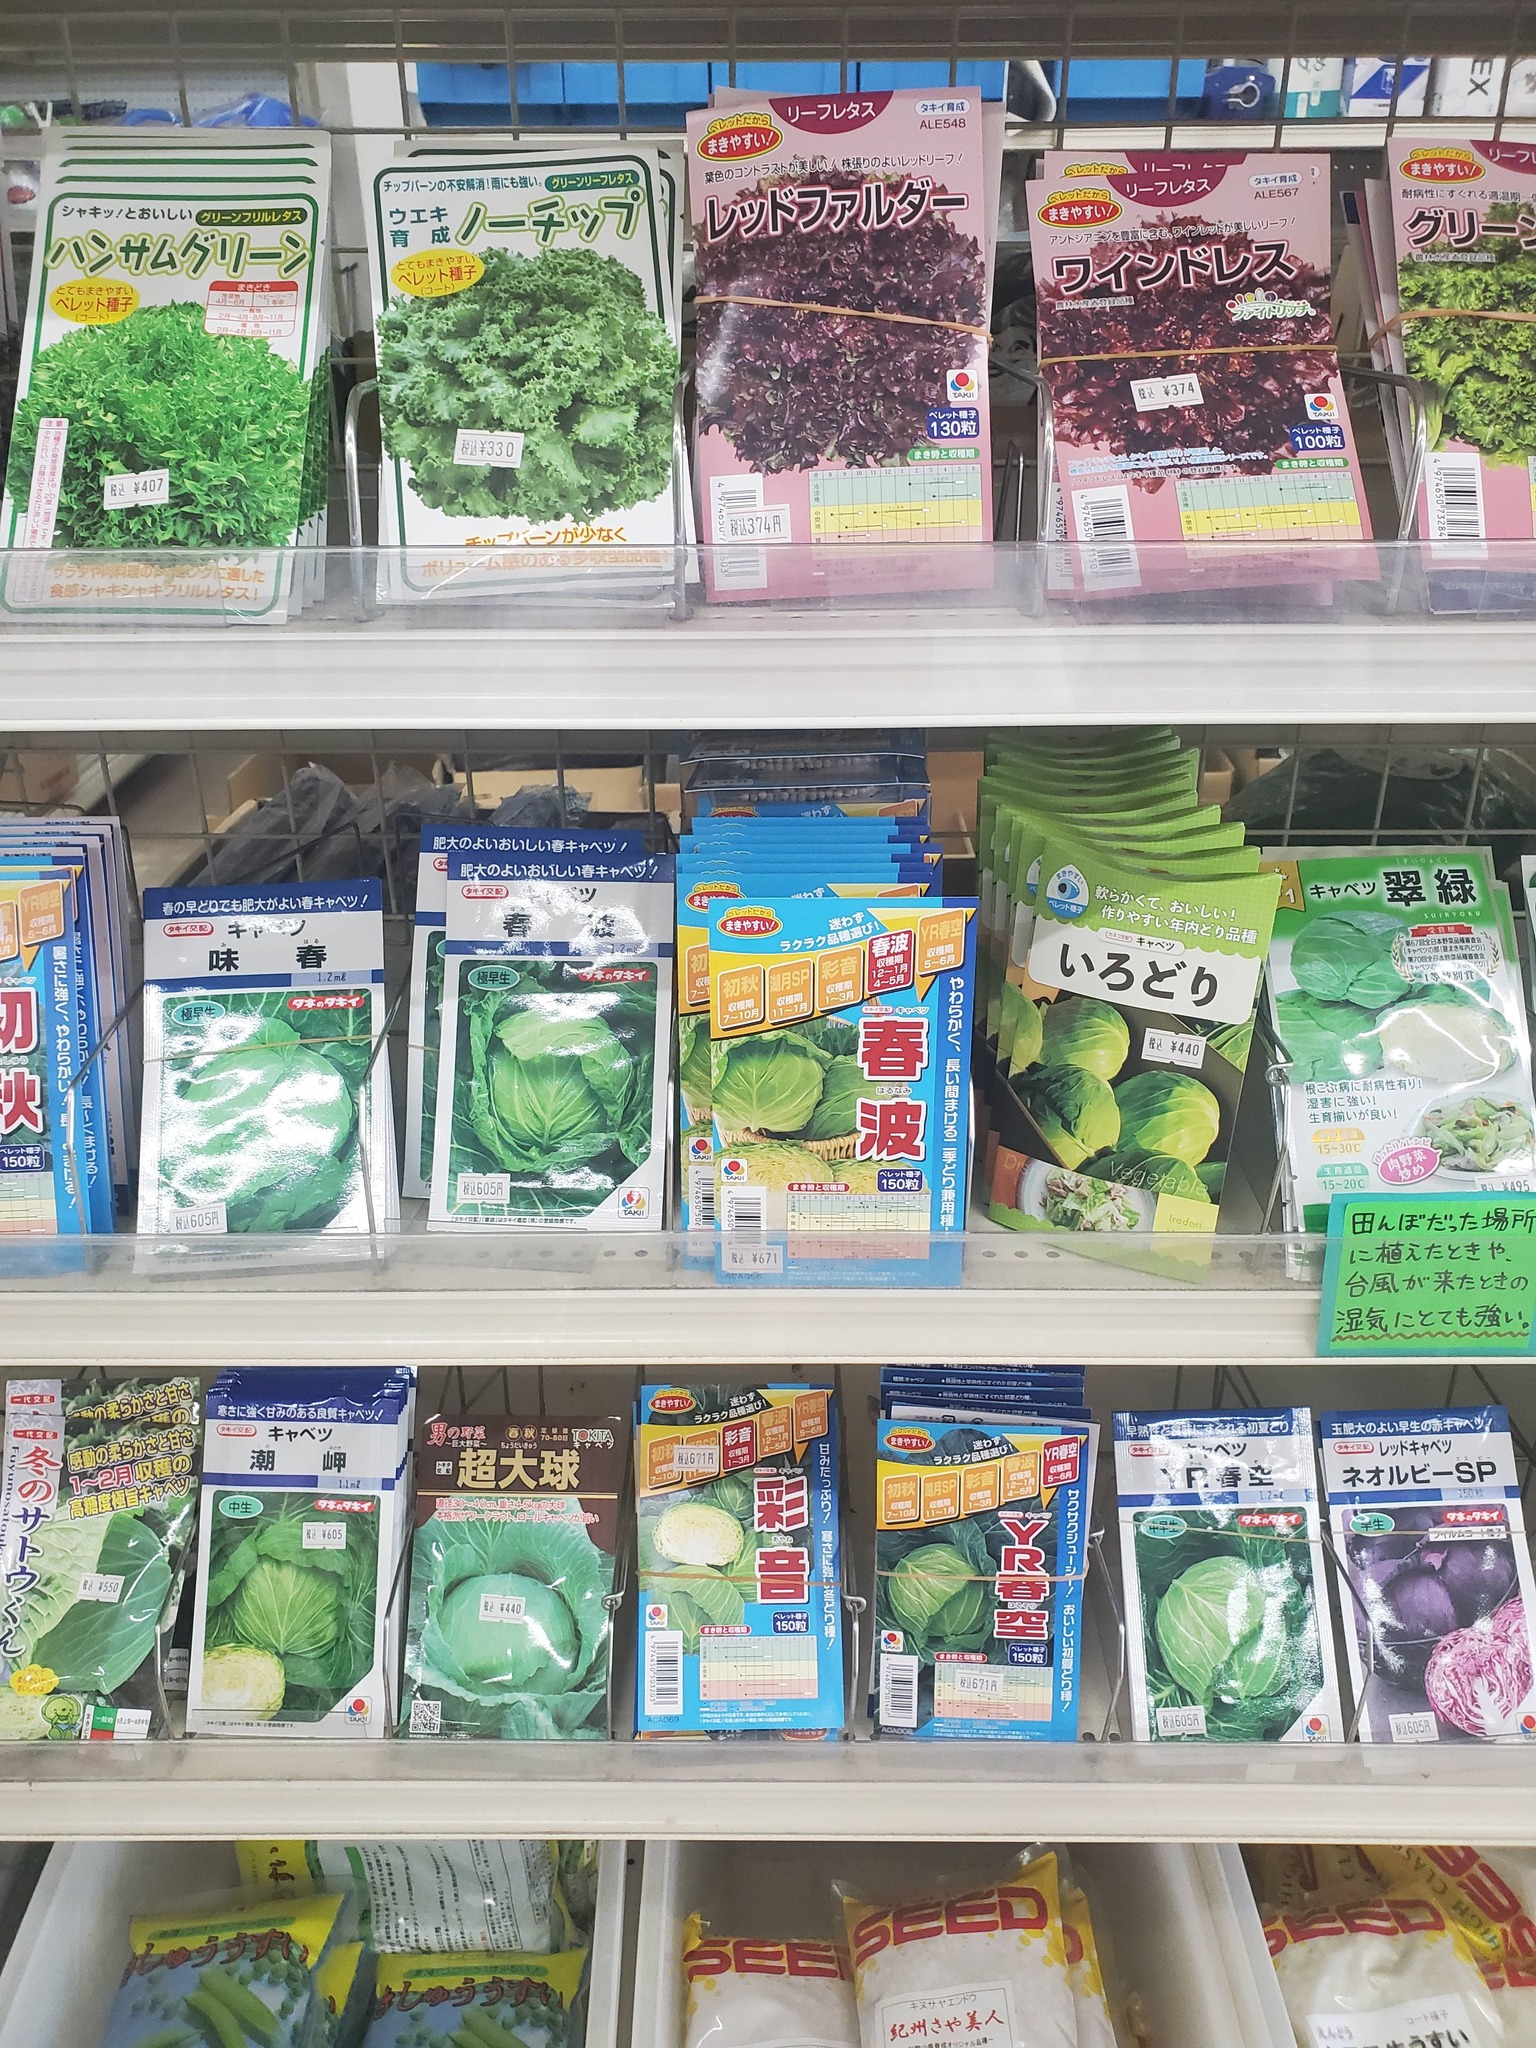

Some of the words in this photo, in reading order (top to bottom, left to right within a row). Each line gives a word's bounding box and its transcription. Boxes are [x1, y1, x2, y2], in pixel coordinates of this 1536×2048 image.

[786, 101, 877, 123] リーフレタス
[919, 102, 966, 114] タキイ育成
[710, 114, 769, 133] ペレットだから
[919, 118, 967, 130] ALE548
[707, 132, 775, 155] まきやすい!
[1410, 163, 1476, 176] まきやすい!
[383, 174, 543, 194] チップバーンの不安解消!雨にも強い。
[551, 173, 634, 189] グリーンリーフレタス
[1253, 174, 1299, 185] タキイ育成
[1050, 190, 1109, 202] ペレットだから
[1126, 180, 1212, 198] リーフレタス
[1253, 187, 1300, 200] ALE567
[62, 205, 192, 220] シャキッ!とおいしい
[200, 209, 303, 223] グリーンフリルレタス
[389, 206, 449, 225] ウエキ
[457, 187, 644, 244] ノーチップ
[708, 177, 968, 241] レッドファルダー
[1048, 204, 1113, 222] まきやすい!
[48, 230, 309, 277] ハンサムグリーン
[396, 253, 476, 272] とてもまきやすい
[1054, 240, 1298, 294] ワインドレス
[398, 264, 478, 284] ペレット種子
[56, 285, 134, 297] とてもまきやすい
[420, 283, 455, 296] (コート)
[55, 296, 133, 313] ペレット種子
[1234, 304, 1311, 320] ファイトリッチ
[1163, 381, 1195, 397] ¥374
[928, 408, 977, 420] ペレット種子
[930, 419, 978, 438] 130粒
[1291, 425, 1341, 437] ペレット種子
[1294, 434, 1343, 450] 100粒
[914, 449, 975, 460] まき時と収穫期
[1281, 458, 1344, 470] まき時と収穫期
[133, 477, 164, 495] ¥407
[433, 835, 628, 854] 肥大のよいおいしい春キャベツ!
[460, 862, 659, 880] 肥大のよいおいしい春キャベツ!
[465, 887, 504, 895] タキイ交配
[1309, 881, 1377, 899] キャベツ
[1382, 868, 1477, 907] 翠緑
[162, 894, 369, 916] 春の早どりでも肥大がよい春キャベツ!
[1048, 899, 1084, 915] ペレット種子
[1095, 884, 1236, 922] 軟らかくて、おいしい!
[728, 908, 772, 918] ペレットだから
[828, 911, 864, 930] 迷わず
[1424, 911, 1481, 919] SUIRYOKU
[167, 925, 208, 933] タキイ交配
[725, 920, 775, 932] まきやすい!
[921, 918, 963, 943] YR春空
[1102, 904, 1258, 945] 作りやすい年内どり品種
[779, 921, 881, 951] ラクラク品種選び!
[1136, 936, 1175, 951] キャベツ
[872, 934, 909, 957] 春波
[926, 944, 954, 957] 収穫期
[821, 955, 858, 979] 彩音
[876, 955, 903, 969] 収穫期
[476, 971, 511, 985] 極早生
[582, 969, 647, 981] タネのタキイ
[769, 968, 810, 993] 湖月SP
[1059, 943, 1218, 1007] いろどり
[722, 978, 759, 996] 初秋
[825, 981, 853, 995] 収穫期
[291, 996, 361, 1009] タネのタキイ
[728, 998, 755, 1012] 収穫期
[776, 992, 803, 1006] 収穫期
[1170, 1040, 1200, 1057] ¥440
[858, 1019, 927, 1159] 春波
[1304, 1077, 1423, 1096] 根こぶ病に耐病性有り!
[1306, 1096, 1377, 1110] 湿害に強い!
[1309, 1109, 1398, 1125] 生育揃いが良い!
[2, 1155, 42, 1168] 150粒
[1386, 1149, 1427, 1171] 肉野菜
[879, 1170, 921, 1179] ペレット種子
[1109, 1160, 1210, 1197] Vegetable
[463, 1181, 504, 1196] 税込605円
[792, 1184, 846, 1192] まき時と収穫期
[880, 1178, 920, 1191] 150粒
[1168, 1213, 1203, 1229] Irodori
[1351, 1207, 1536, 1235] 田んぼだった場所
[1349, 1240, 1513, 1265] に植えたときや、
[1344, 1268, 1529, 1298] 台風が来たときの
[1335, 1303, 1530, 1334] 湿気にとても強い。
[653, 1398, 692, 1409] まきやすい!
[729, 1391, 756, 1408] 迷わず
[216, 1404, 384, 1422] 寒さに強く甘みのある良質キャベツ!
[693, 1398, 768, 1425] ラクラク品種選び!
[761, 1408, 789, 1428] 春波
[268, 1425, 334, 1443] キャベツ
[427, 1422, 487, 1446] 男の野菜
[1330, 1416, 1493, 1436] 玉肥大のよい早生の赤キャベツ!
[571, 1429, 615, 1442] TOKITA
[724, 1426, 752, 1447] 彩音
[890, 1437, 930, 1448] まきやすい!
[972, 1436, 1002, 1450] 迷わず
[69, 1429, 194, 1471] 感動の柔らかさと甘さ
[500, 1442, 538, 1450] ちょうだいきゅう
[572, 1441, 615, 1450] キャベツ
[933, 1443, 1014, 1465] ラクラク品種選び!
[1044, 1442, 1078, 1462] YR春空
[1379, 1440, 1452, 1457] レッドキャベツ
[456, 1448, 581, 1491] 超大球
[1006, 1455, 1035, 1472] 春波
[965, 1470, 996, 1489] 彩音
[1342, 1460, 1497, 1488] ネオルビーSP
[69, 1477, 192, 1520] 高糖度極旨キャベツ
[886, 1482, 916, 1499] 初秋
[228, 1501, 253, 1514] 中生
[317, 1500, 372, 1512] タネのタキイ
[1240, 1513, 1299, 1526] タネのタキイ
[1446, 1511, 1500, 1522] タネのタキイ
[321, 1528, 344, 1541] ¥605
[755, 1477, 808, 1602] 彩音
[0, 1446, 61, 1658] 冬のサトウくん
[98, 1581, 119, 1593] ¥550
[499, 1602, 522, 1615] ¥440
[774, 1613, 808, 1621] ペレット種子
[775, 1620, 808, 1633] 150粒
[1011, 1645, 1046, 1653] ペレット種子
[1012, 1652, 1044, 1664] 150粒
[853, 1886, 1049, 1968] SEED
[910, 1993, 977, 2012] キヌサヤエンドウ
[890, 2009, 1005, 2042] 紀州さや美人
